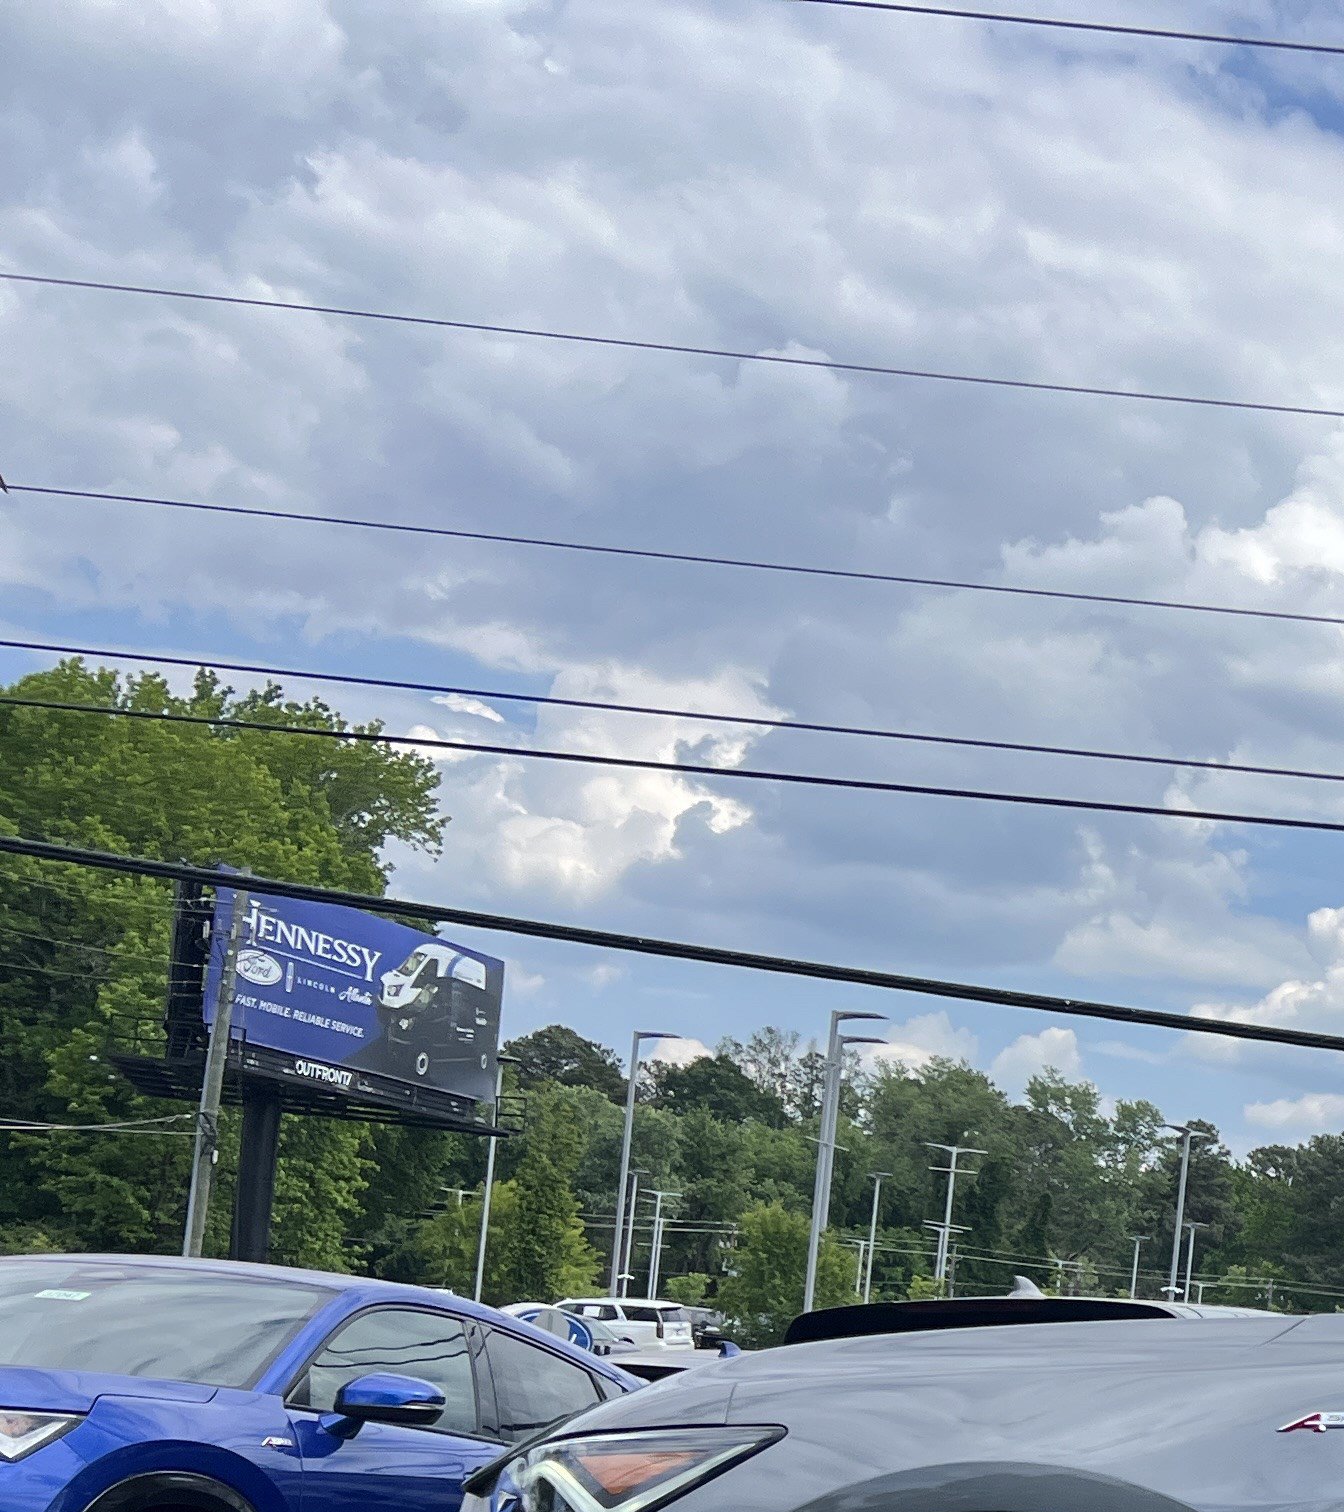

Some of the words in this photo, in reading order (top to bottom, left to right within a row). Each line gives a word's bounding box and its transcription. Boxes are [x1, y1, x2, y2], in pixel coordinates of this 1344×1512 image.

[242, 899, 382, 982] HENNESSY
[297, 976, 336, 994] LINCOLN
[235, 993, 258, 1009] FAST.
[259, 1000, 292, 1018] MOBILE.
[292, 1009, 331, 1029] RELIABLE
